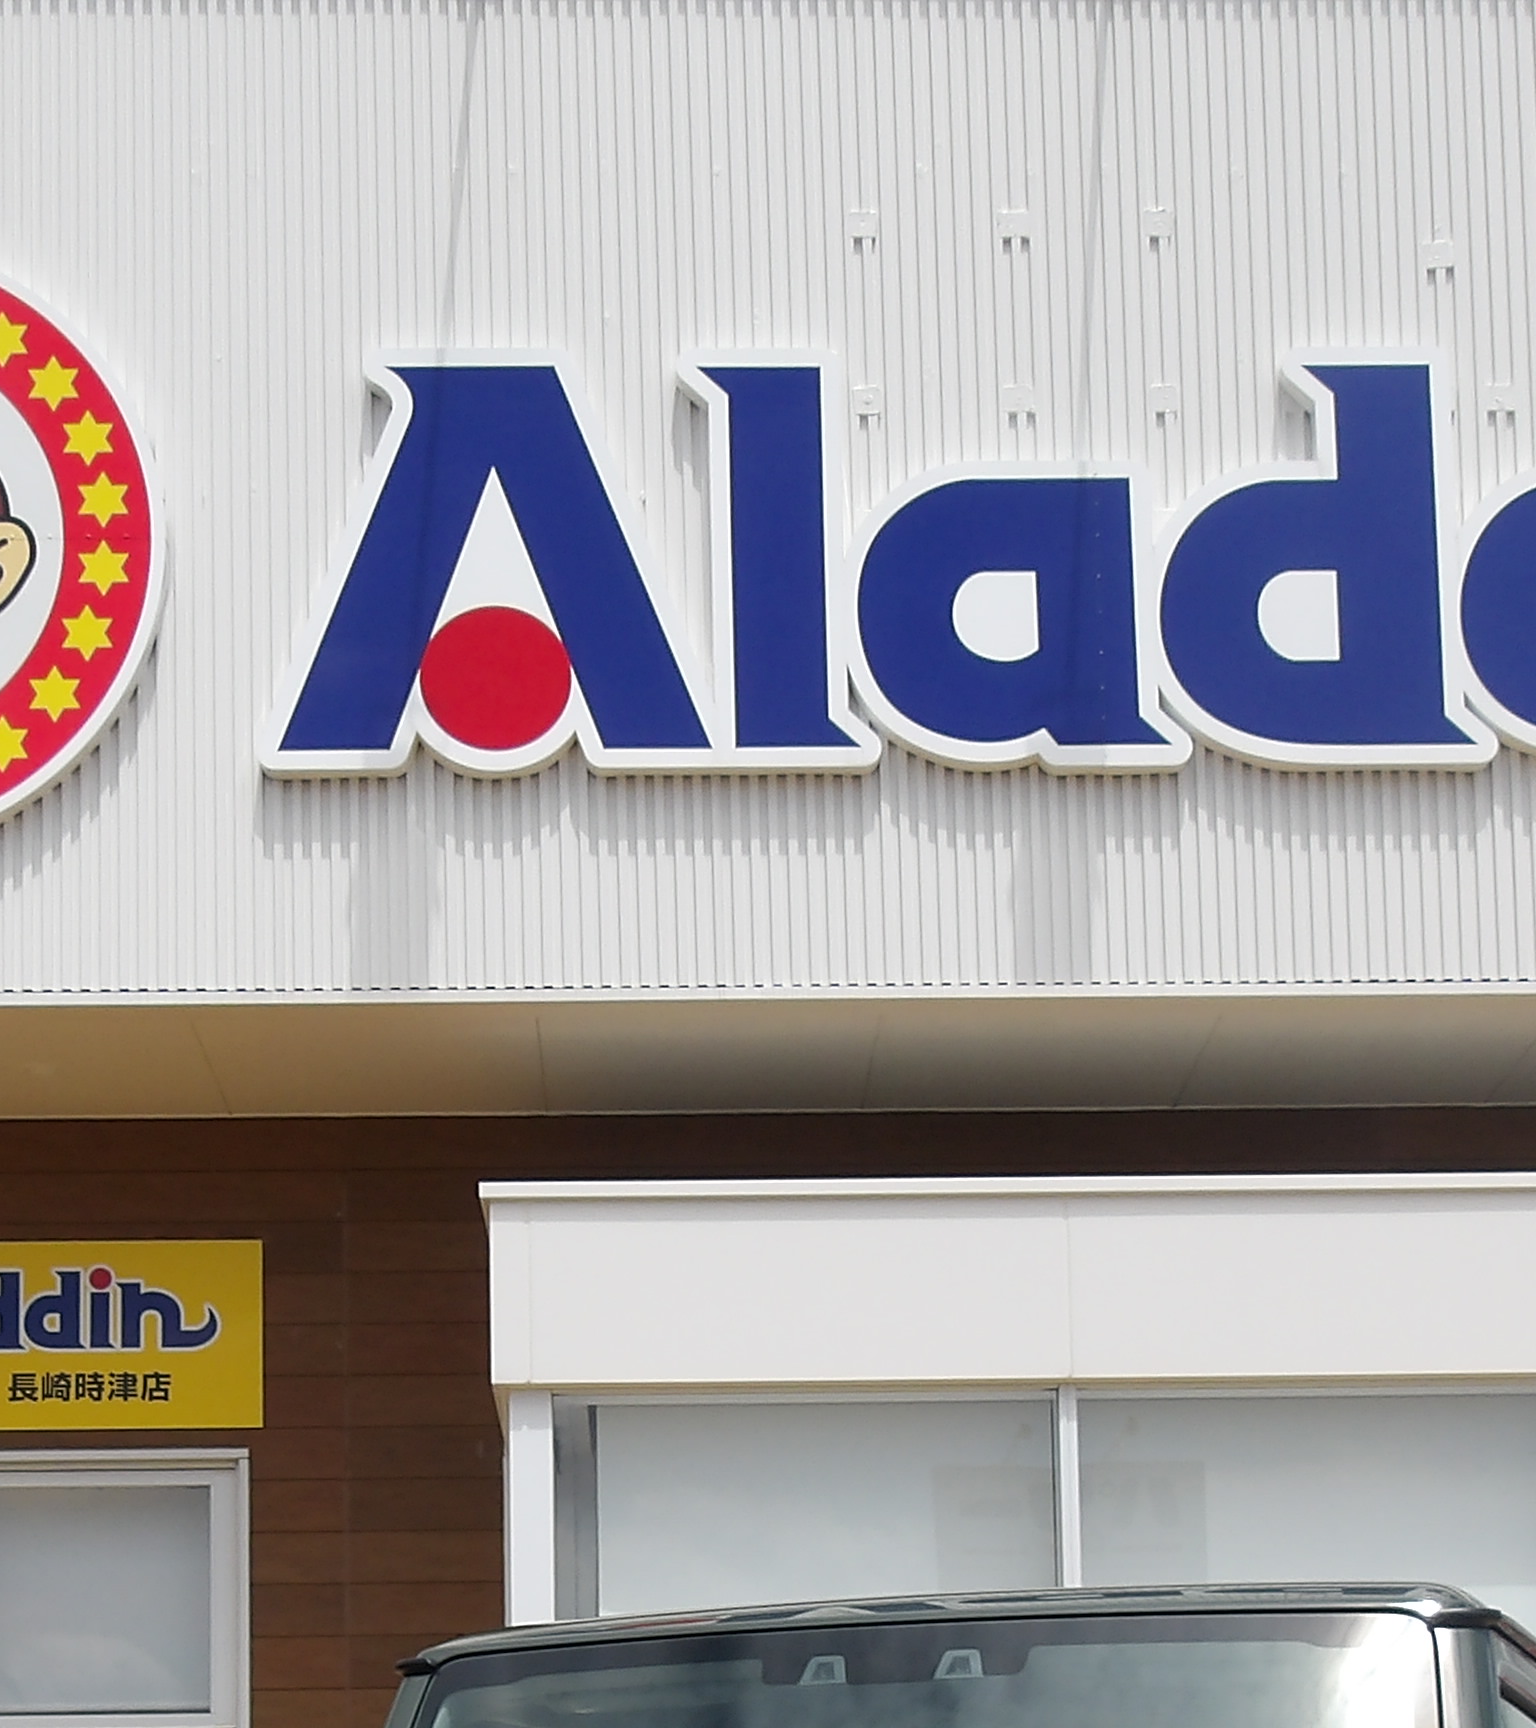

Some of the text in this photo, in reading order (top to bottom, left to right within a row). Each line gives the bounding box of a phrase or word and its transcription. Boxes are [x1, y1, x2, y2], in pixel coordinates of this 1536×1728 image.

[7, 1371, 172, 1402] 長崎時津店
